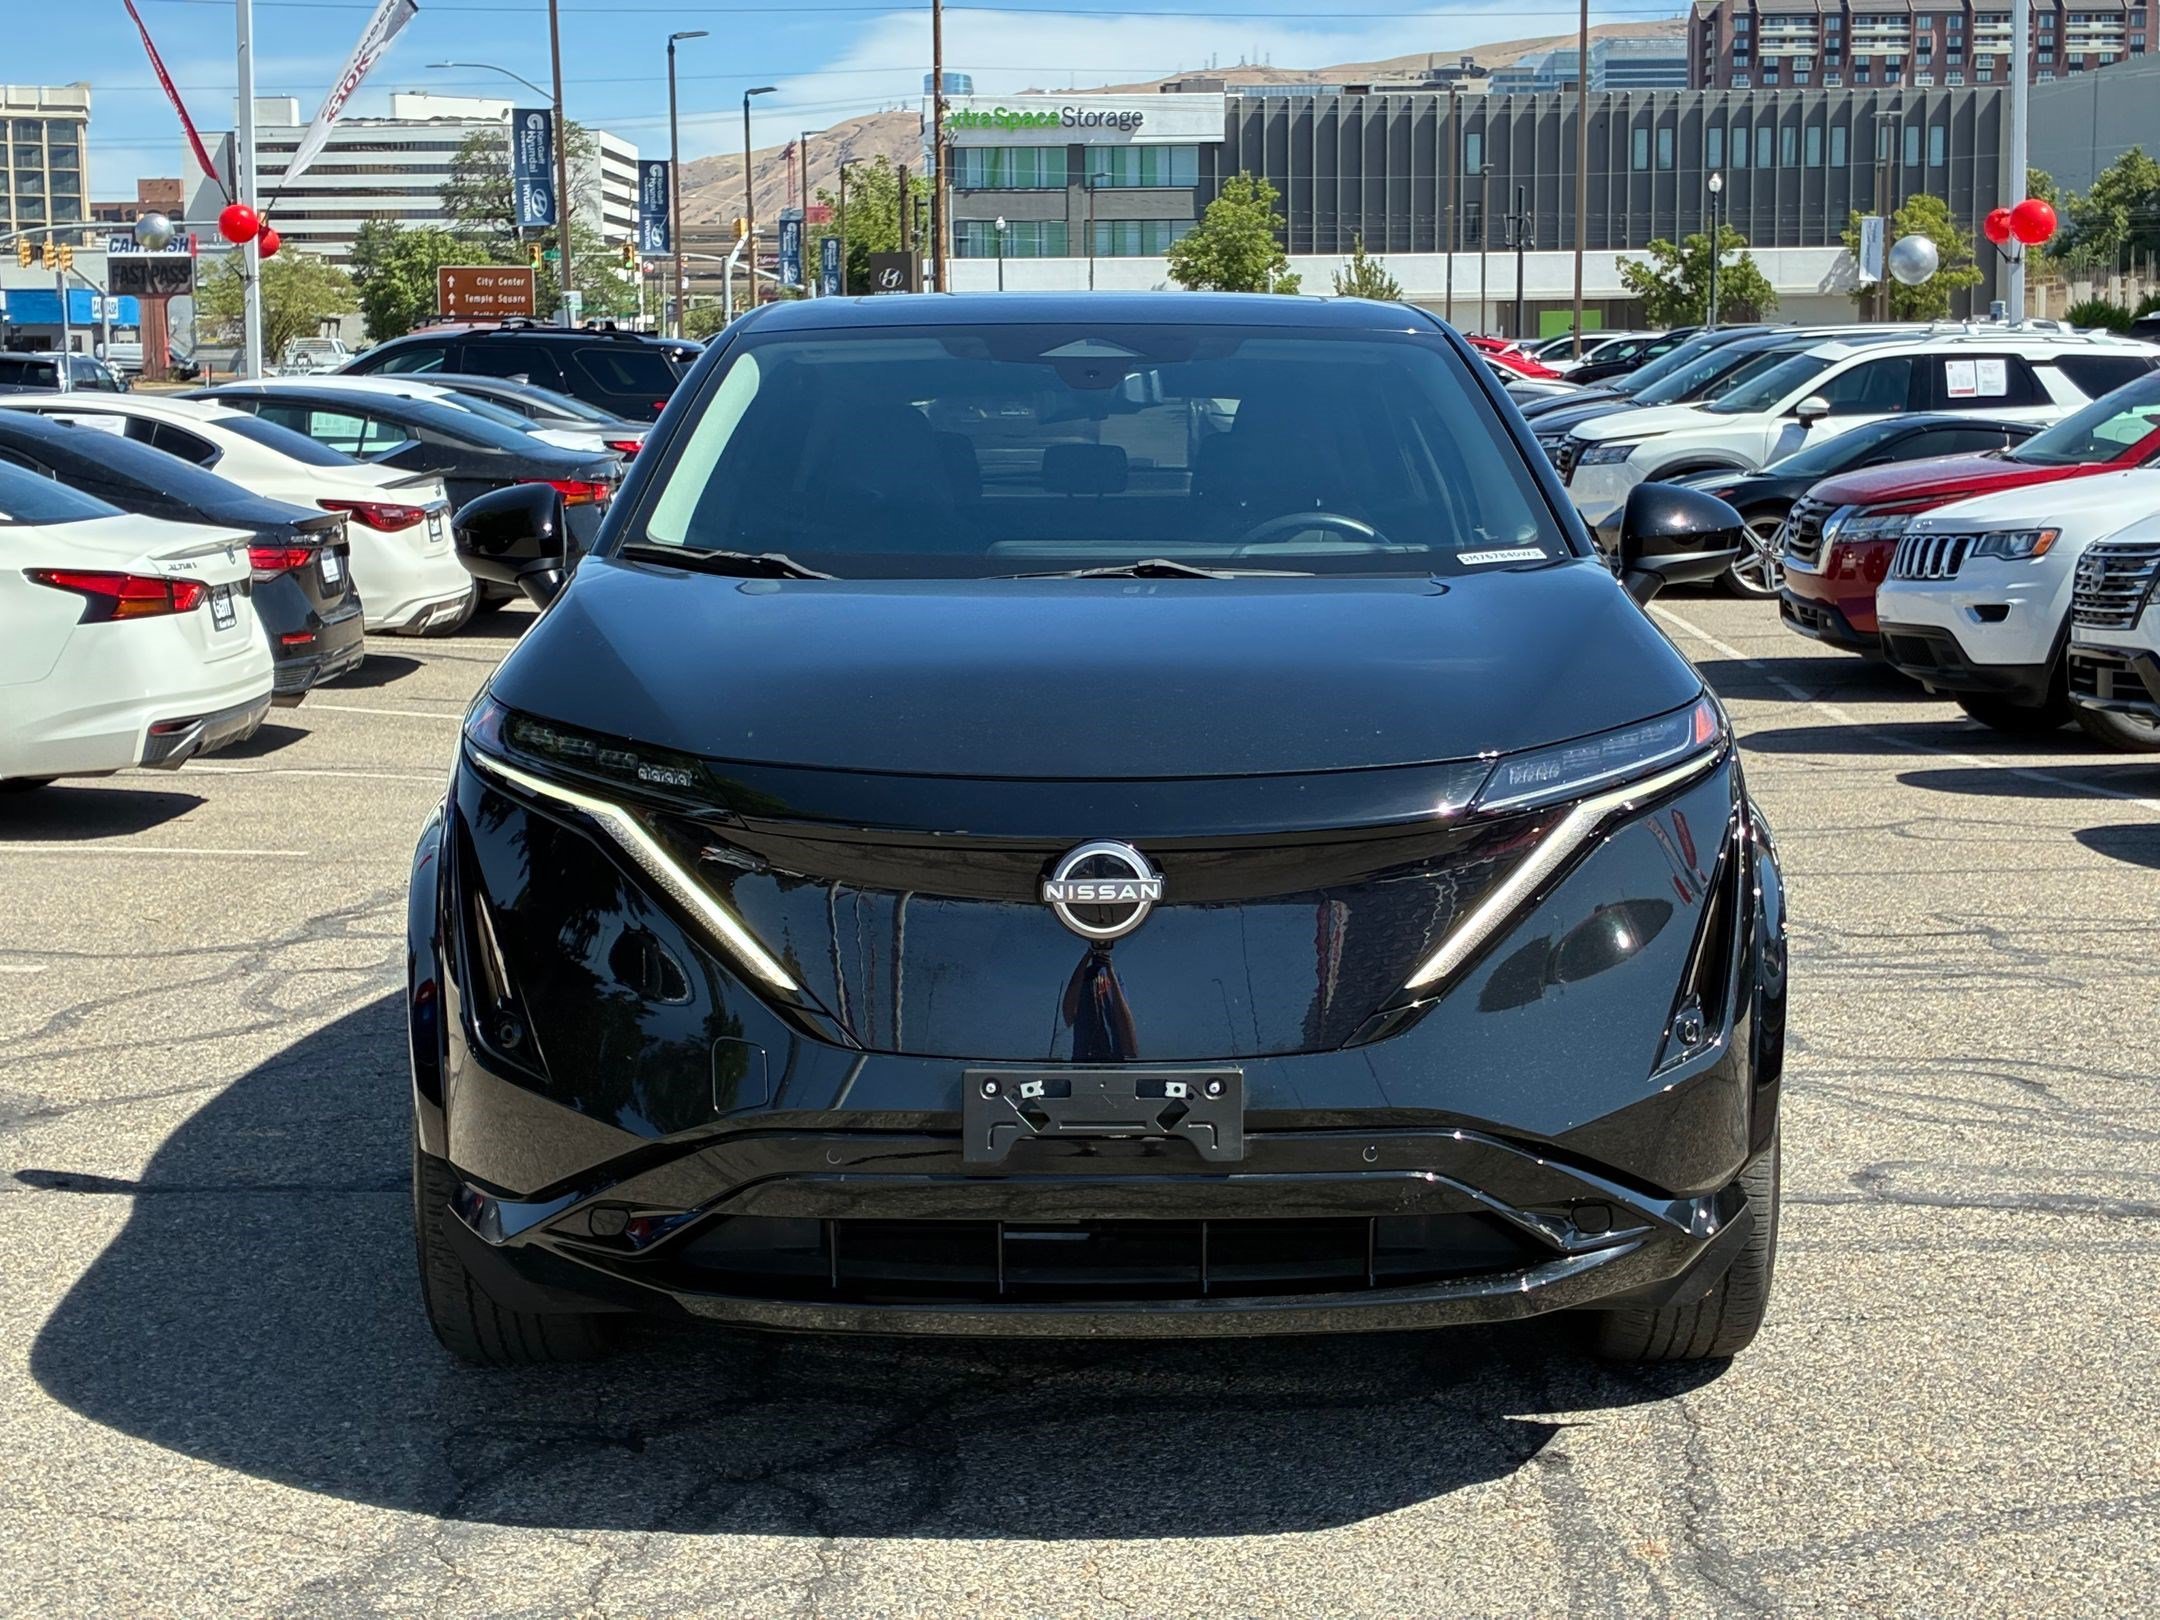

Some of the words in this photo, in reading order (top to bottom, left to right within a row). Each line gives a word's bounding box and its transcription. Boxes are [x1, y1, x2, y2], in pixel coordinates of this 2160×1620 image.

[527, 130, 538, 173] Hyundai
[523, 184, 532, 222] HYUNDAI
[476, 277, 493, 287] City
[498, 277, 525, 286] Center
[465, 294, 493, 304] Temple
[498, 294, 526, 304] Square
[1046, 884, 1158, 900] NISSAN
